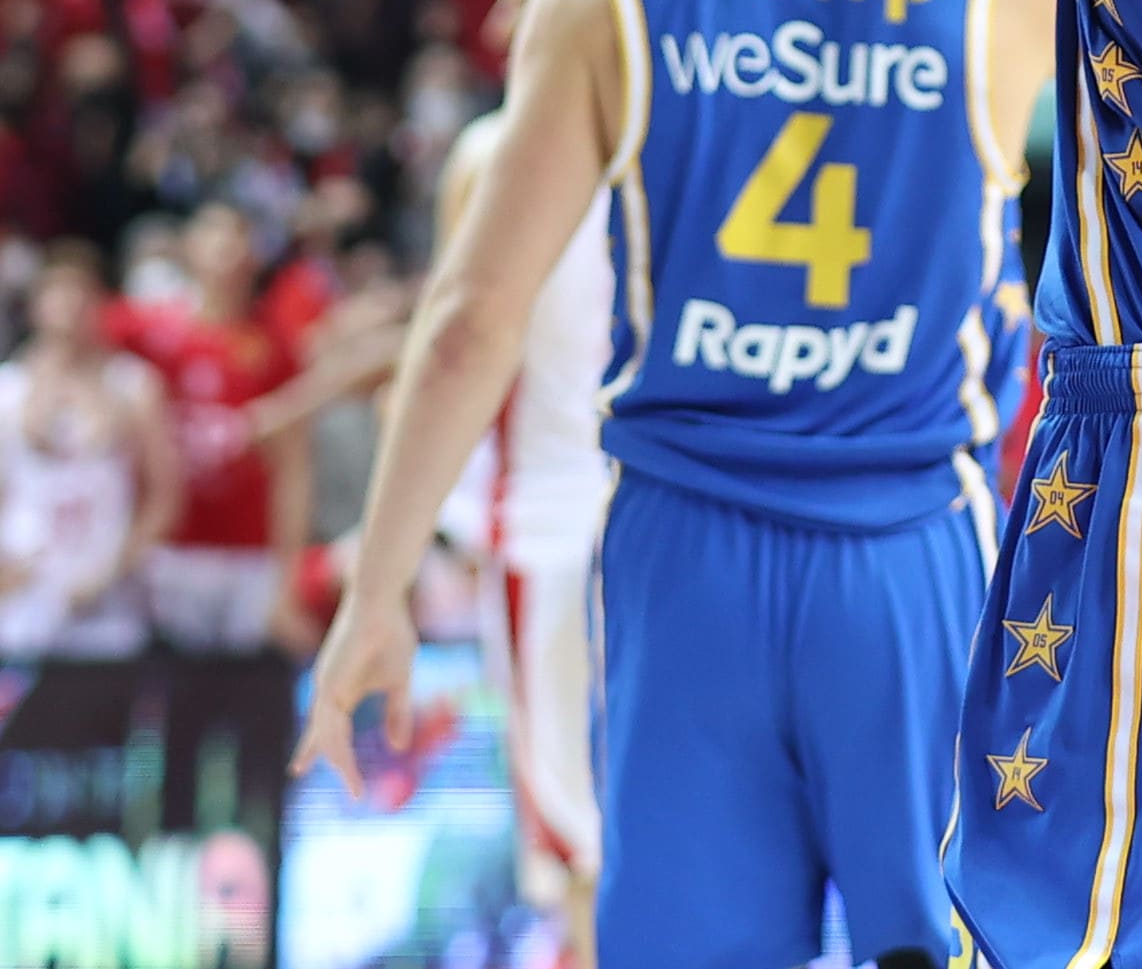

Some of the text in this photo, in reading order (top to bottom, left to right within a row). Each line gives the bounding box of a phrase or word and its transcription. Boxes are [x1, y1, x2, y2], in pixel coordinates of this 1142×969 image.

[659, 19, 949, 111] weSure
[1131, 160, 1142, 176] 14
[715, 110, 872, 310] 4
[672, 298, 919, 395] Rapyd
[1050, 490, 1064, 506] 04
[1033, 633, 1048, 648] 05
